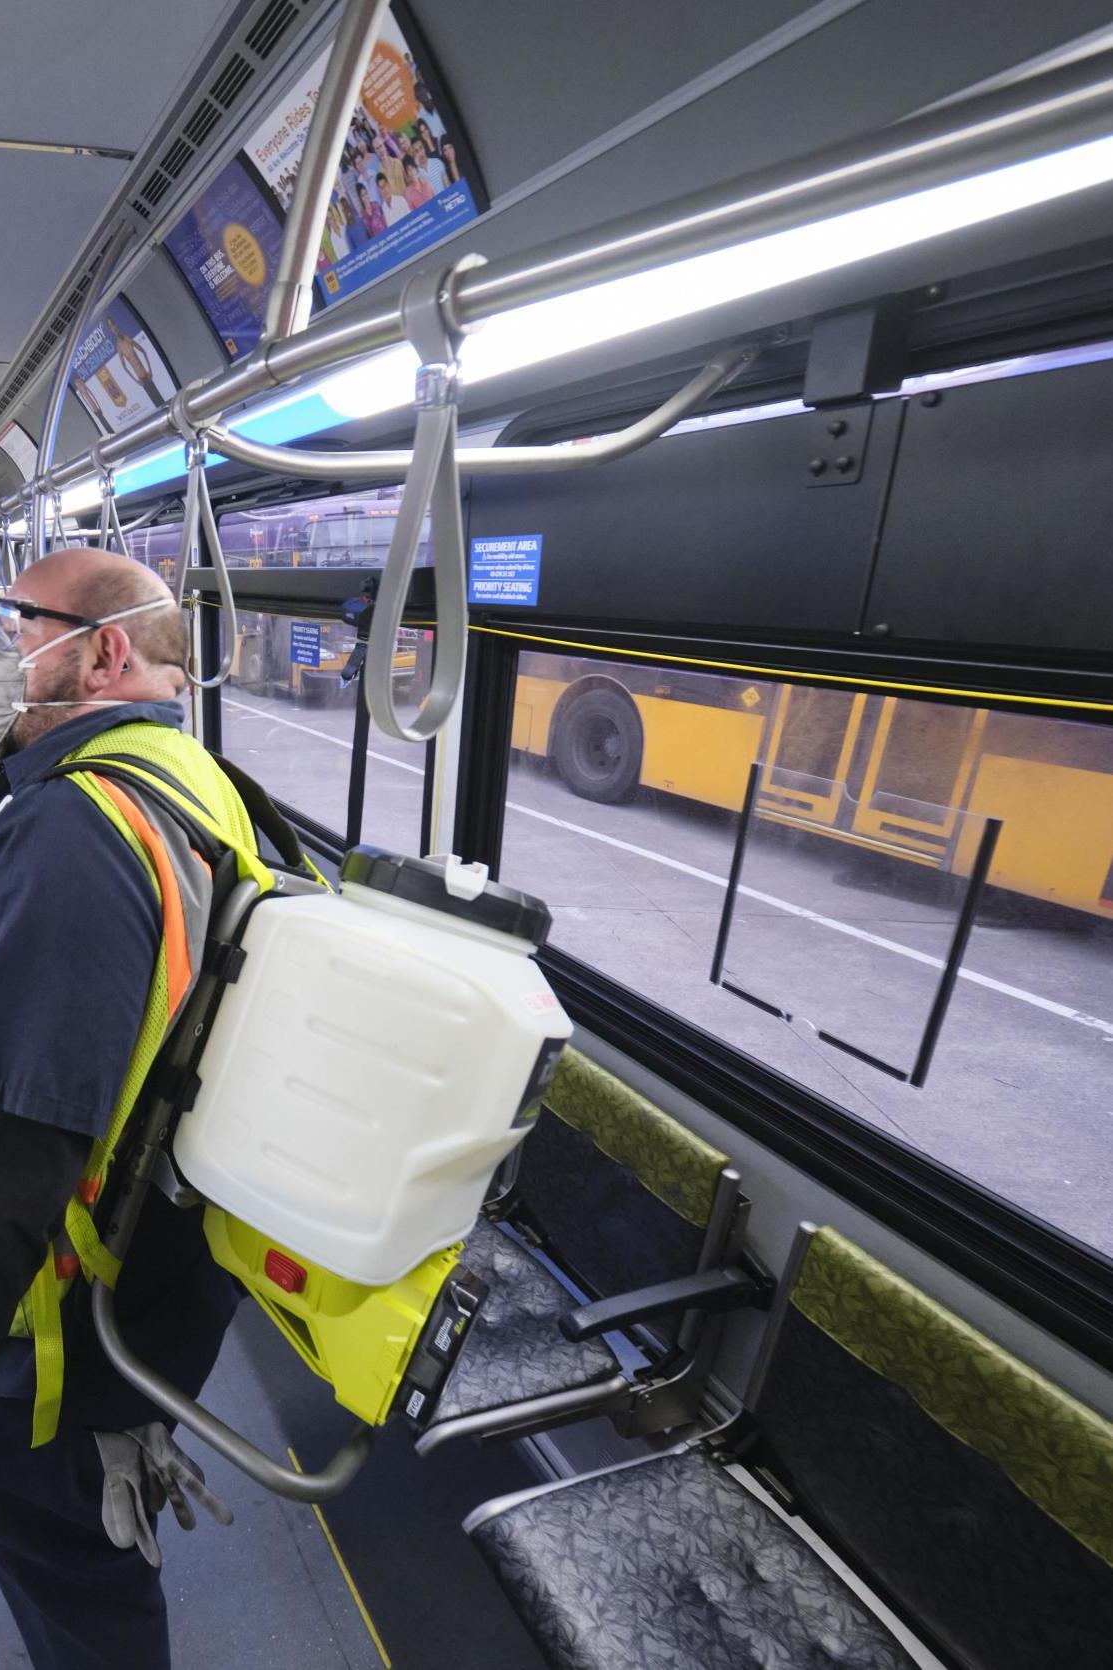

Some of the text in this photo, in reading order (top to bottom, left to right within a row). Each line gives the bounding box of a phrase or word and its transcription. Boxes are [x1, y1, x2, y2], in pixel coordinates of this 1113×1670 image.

[255, 126, 289, 162] Everyone
[285, 103, 311, 131] Rides
[203, 260, 226, 282] EVERYONE
[205, 257, 216, 270] THIS
[474, 540, 537, 552] SECUREMENT AREA
[473, 581, 532, 592] PRIORITY SEATING
[408, 1392, 422, 1415] RYOBI
